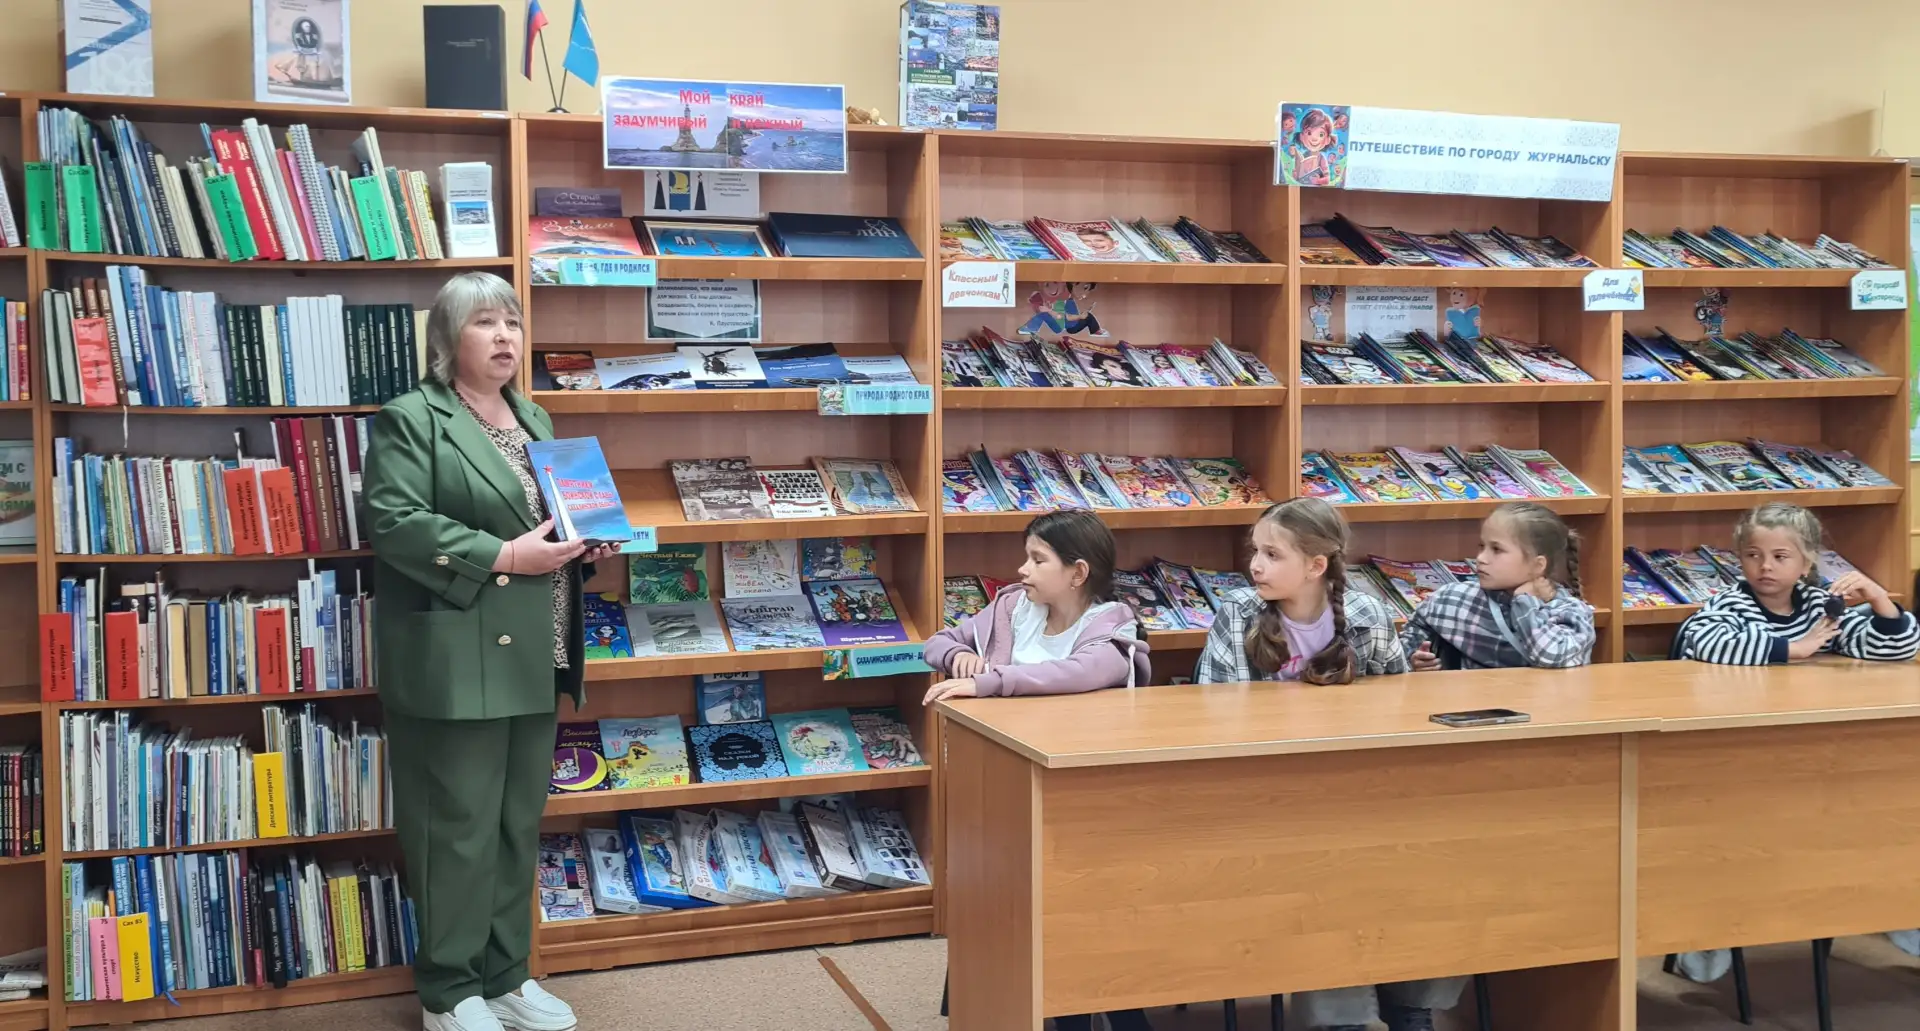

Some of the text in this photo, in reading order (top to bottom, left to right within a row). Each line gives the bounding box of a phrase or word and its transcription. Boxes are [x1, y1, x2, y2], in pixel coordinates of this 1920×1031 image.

[679, 90, 764, 108] Мой край
[614, 115, 708, 130] задумчивый
[745, 117, 803, 130] нежный
[1350, 141, 1611, 166] ПУТЕШЕСТВИЕ ПО ГОРОДУ ЖУРНАЛЬСКУ
[576, 263, 599, 273] ЗЕЯ,
[601, 263, 612, 273] ГДЕ
[620, 264, 649, 273] РОДИЛСЯ
[948, 269, 998, 283] Классным
[1602, 278, 1619, 287] Для
[948, 289, 1001, 303] девчонкам
[856, 390, 930, 401] ПРИРОДА РОДНОГО КРАЯ
[293, 617, 302, 681] Игорь Фархутдинов
[857, 654, 892, 666] САХАЛИНСКИЕ
[892, 652, 913, 663] АВТОРЫ
[266, 768, 276, 828] Детская литература
[132, 952, 141, 984] Искусство
[102, 967, 111, 1000] Физическая
